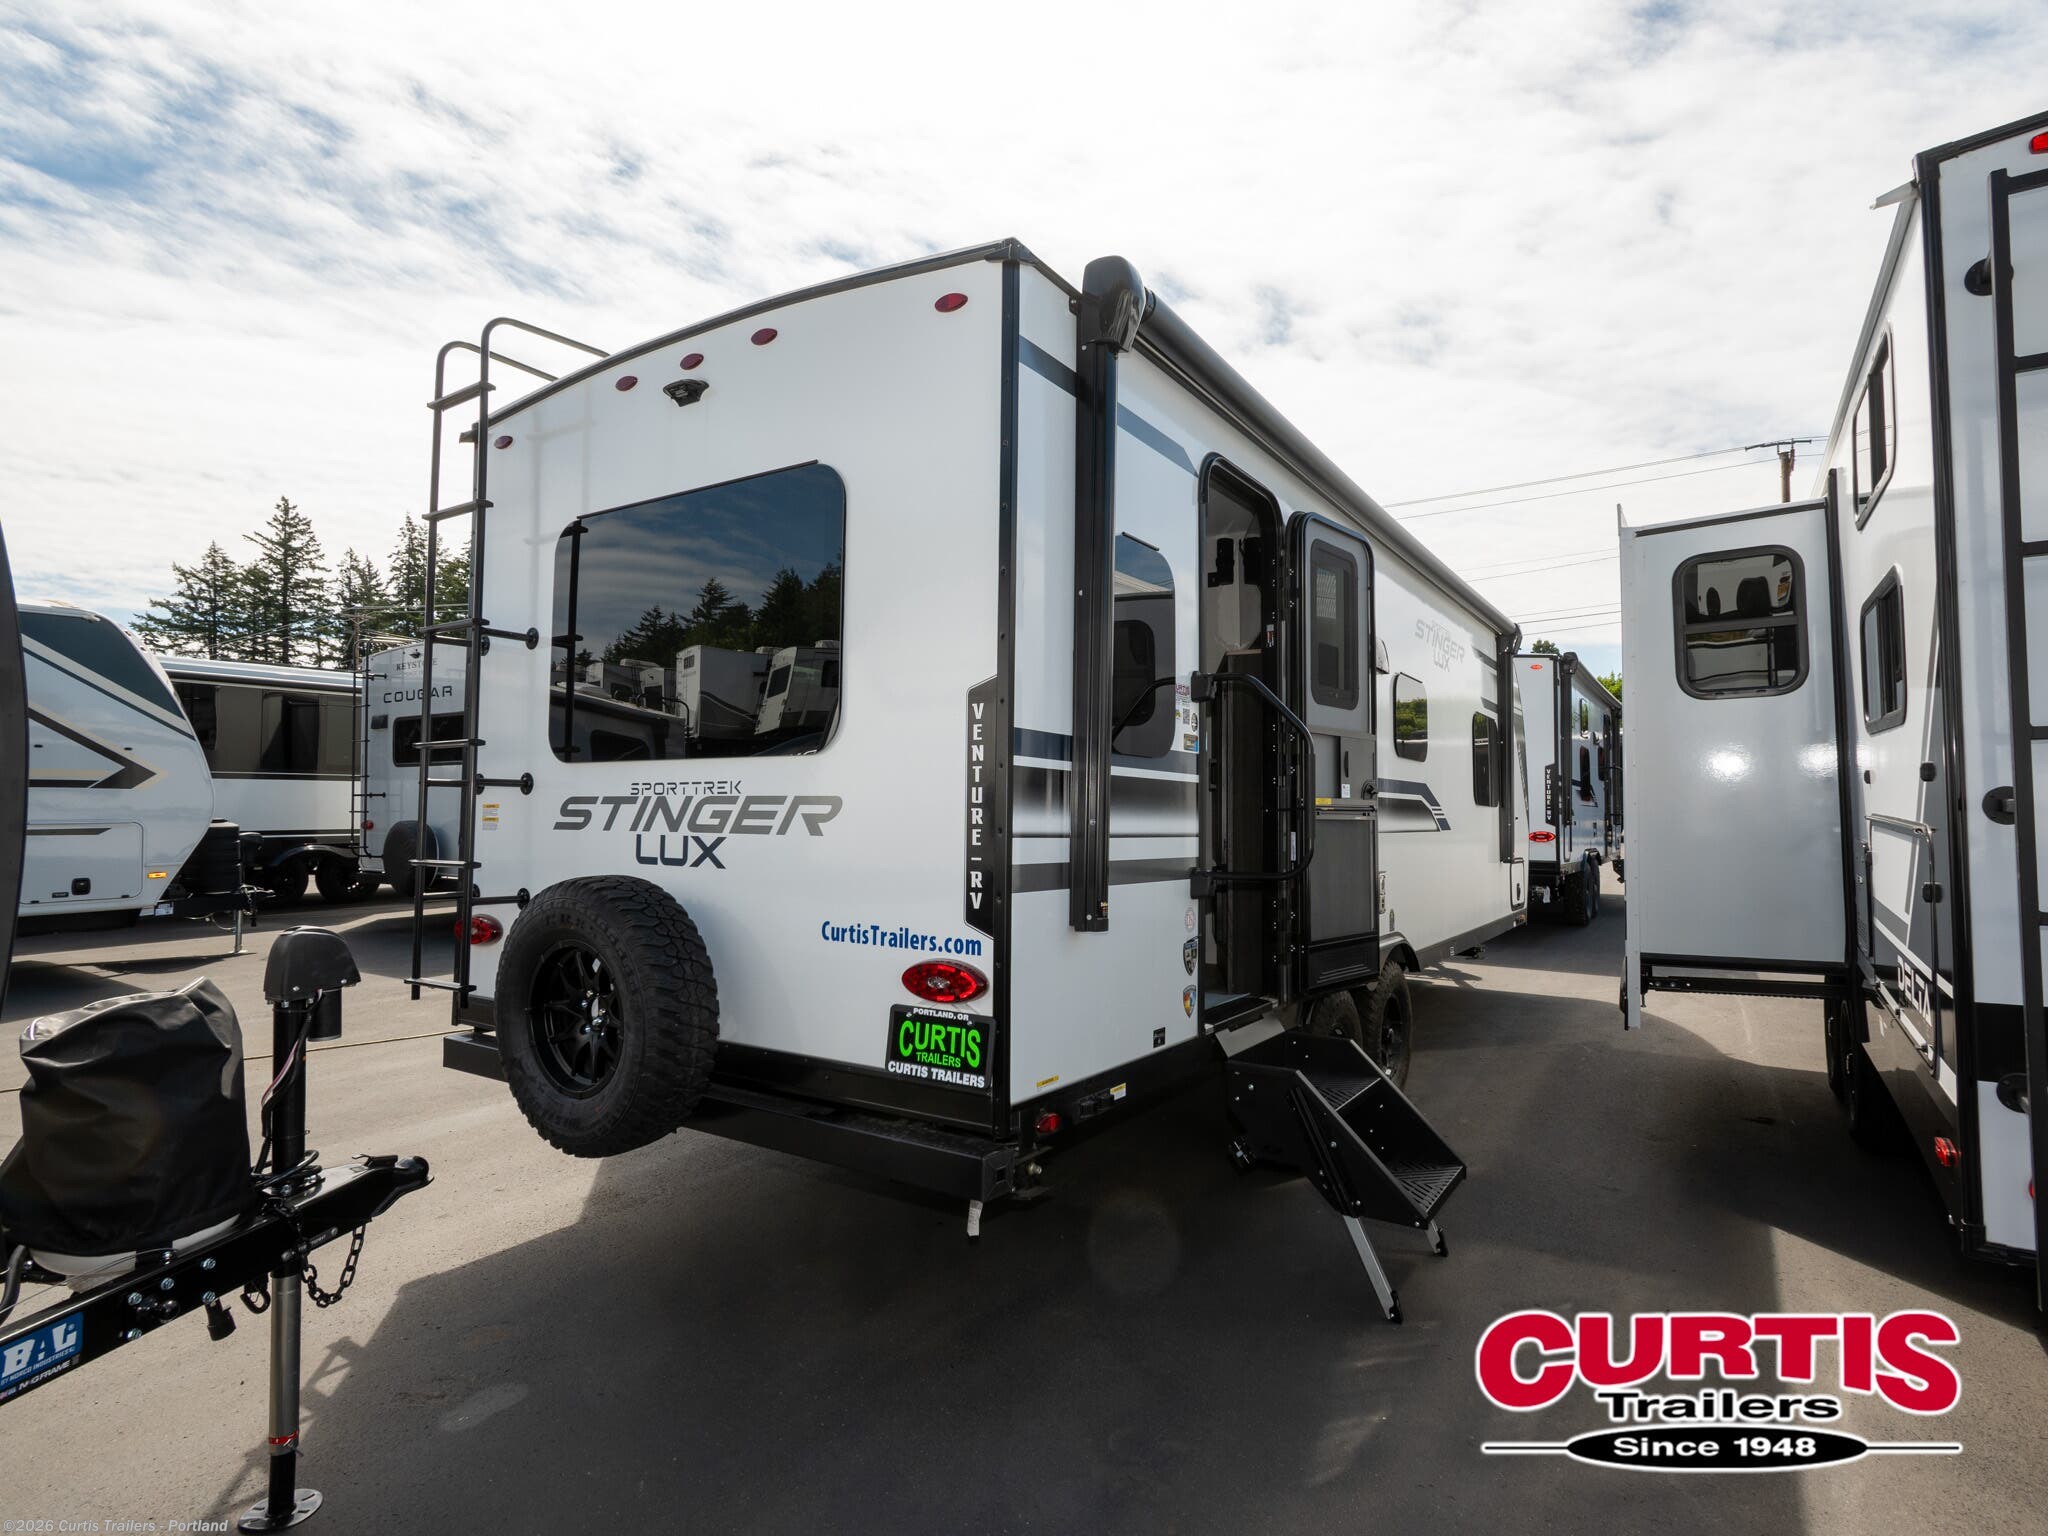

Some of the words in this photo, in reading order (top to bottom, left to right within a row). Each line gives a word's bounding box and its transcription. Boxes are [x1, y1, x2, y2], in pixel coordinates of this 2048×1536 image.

[383, 686, 453, 703] COUGAR
[630, 780, 741, 795] SPORTTREK
[553, 795, 843, 837] STINGER
[636, 834, 727, 869] LUX
[821, 920, 982, 956] CurtisTrailers.com
[1897, 954, 1933, 1028] DELTA
[913, 1007, 957, 1020] PORTLAND,
[957, 1013, 969, 1021] OR
[899, 1020, 981, 1068] CURTIS
[888, 1061, 929, 1078] CURTIS
[931, 1067, 985, 1089] TRAILERS
[916, 1052, 961, 1068] TRAILERS
